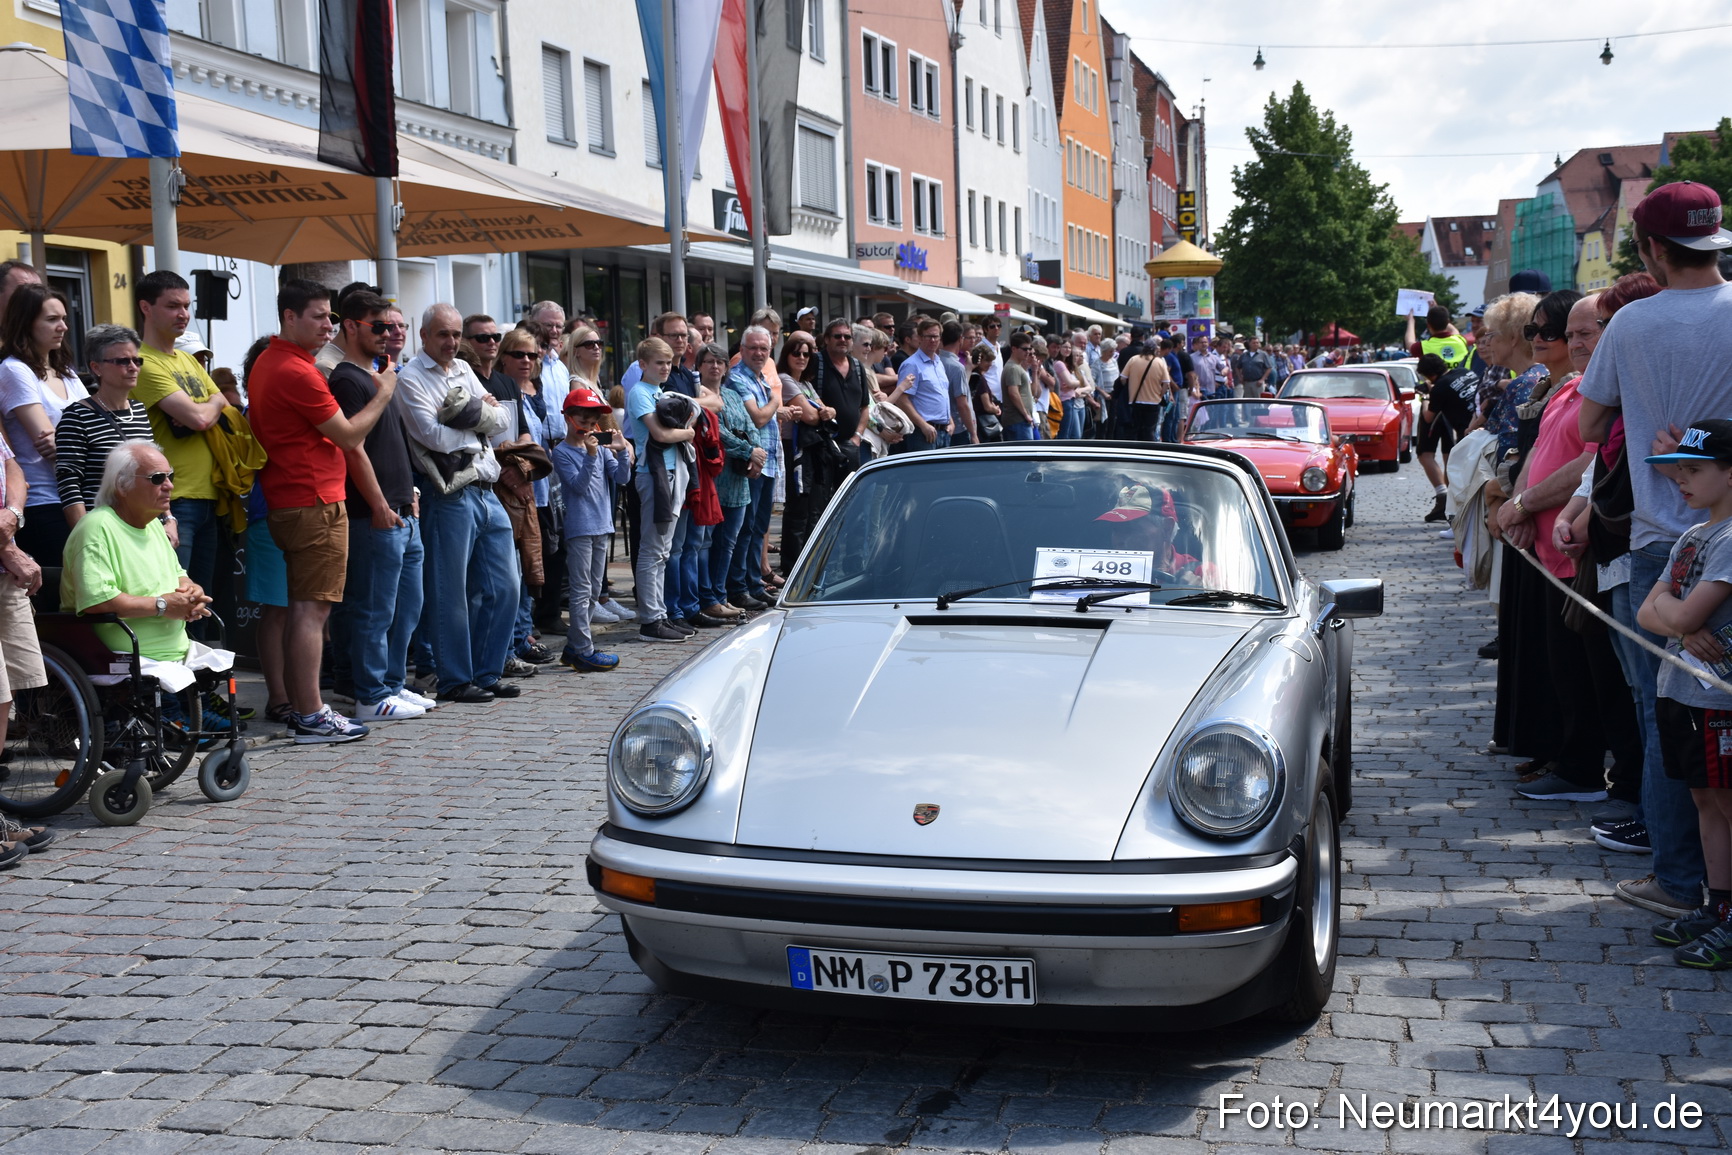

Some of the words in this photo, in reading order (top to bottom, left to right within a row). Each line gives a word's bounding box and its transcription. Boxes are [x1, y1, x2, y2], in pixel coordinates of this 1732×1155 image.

[113, 272, 127, 290] 24
[1091, 560, 1132, 576] 498
[812, 954, 865, 990] NM
[888, 959, 913, 993] P
